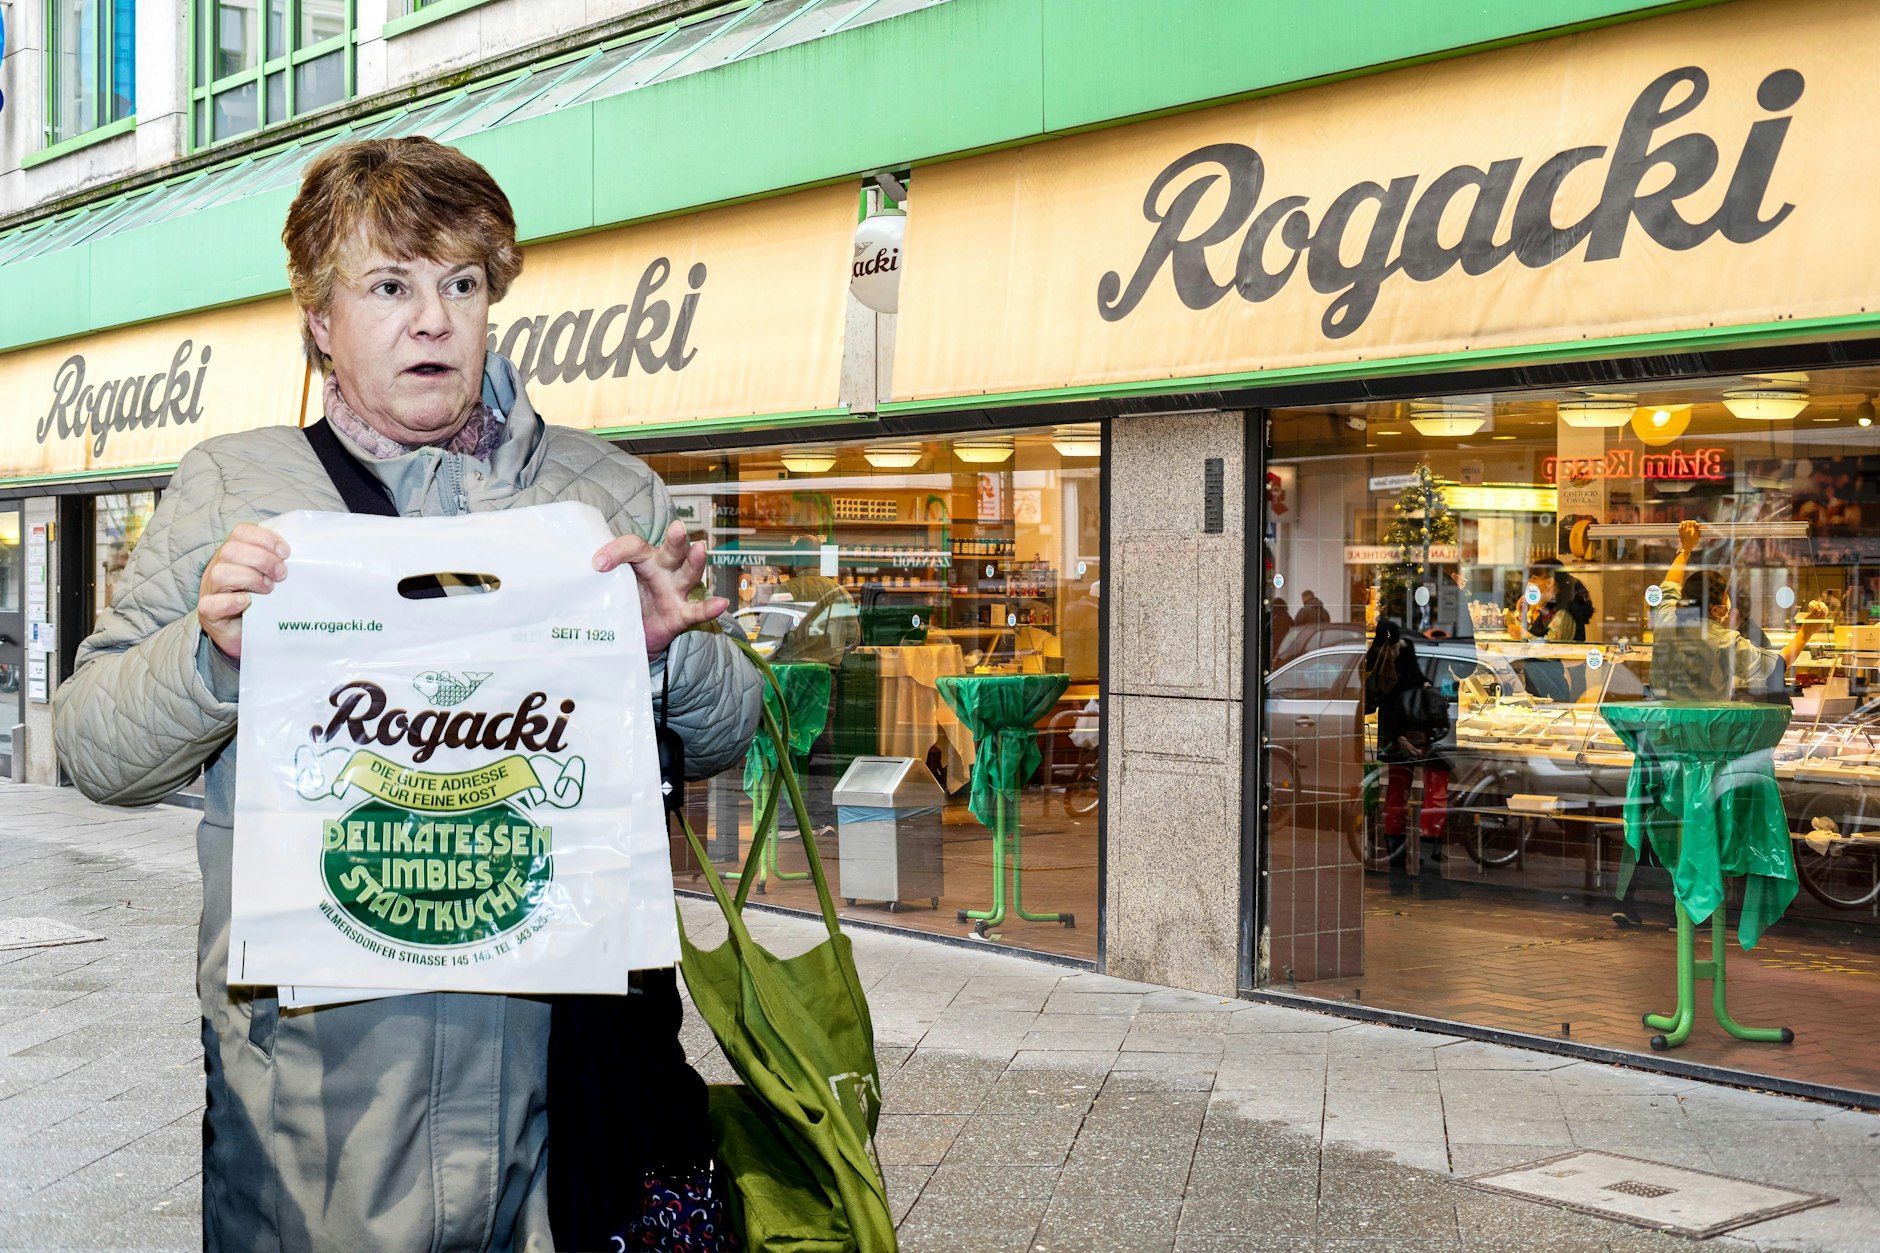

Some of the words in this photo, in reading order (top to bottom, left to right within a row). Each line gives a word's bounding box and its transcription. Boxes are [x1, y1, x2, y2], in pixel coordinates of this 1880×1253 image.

[1097, 66, 1805, 338] Rogacki
[851, 247, 899, 283] acki
[36, 339, 212, 459] Rogacki
[278, 619, 383, 633] www.rogacki.de
[551, 627, 581, 640] SEIT
[586, 629, 616, 642] 1928
[309, 680, 576, 764] Rogacki
[370, 760, 396, 781] DIE
[397, 772, 437, 791] GUTE
[440, 765, 509, 791] ADRESSE
[379, 781, 410, 802] FÜR
[412, 791, 455, 807] FEINE
[459, 784, 497, 806] KOST
[322, 818, 553, 857] DELIKATESSEN
[382, 857, 494, 891] IMBISS
[340, 864, 531, 932] STADTKÜCHE
[318, 899, 396, 959] WILMERSDORFER
[398, 951, 448, 967] STRASSE
[451, 955, 470, 967] 145
[514, 927, 533, 945] 343
